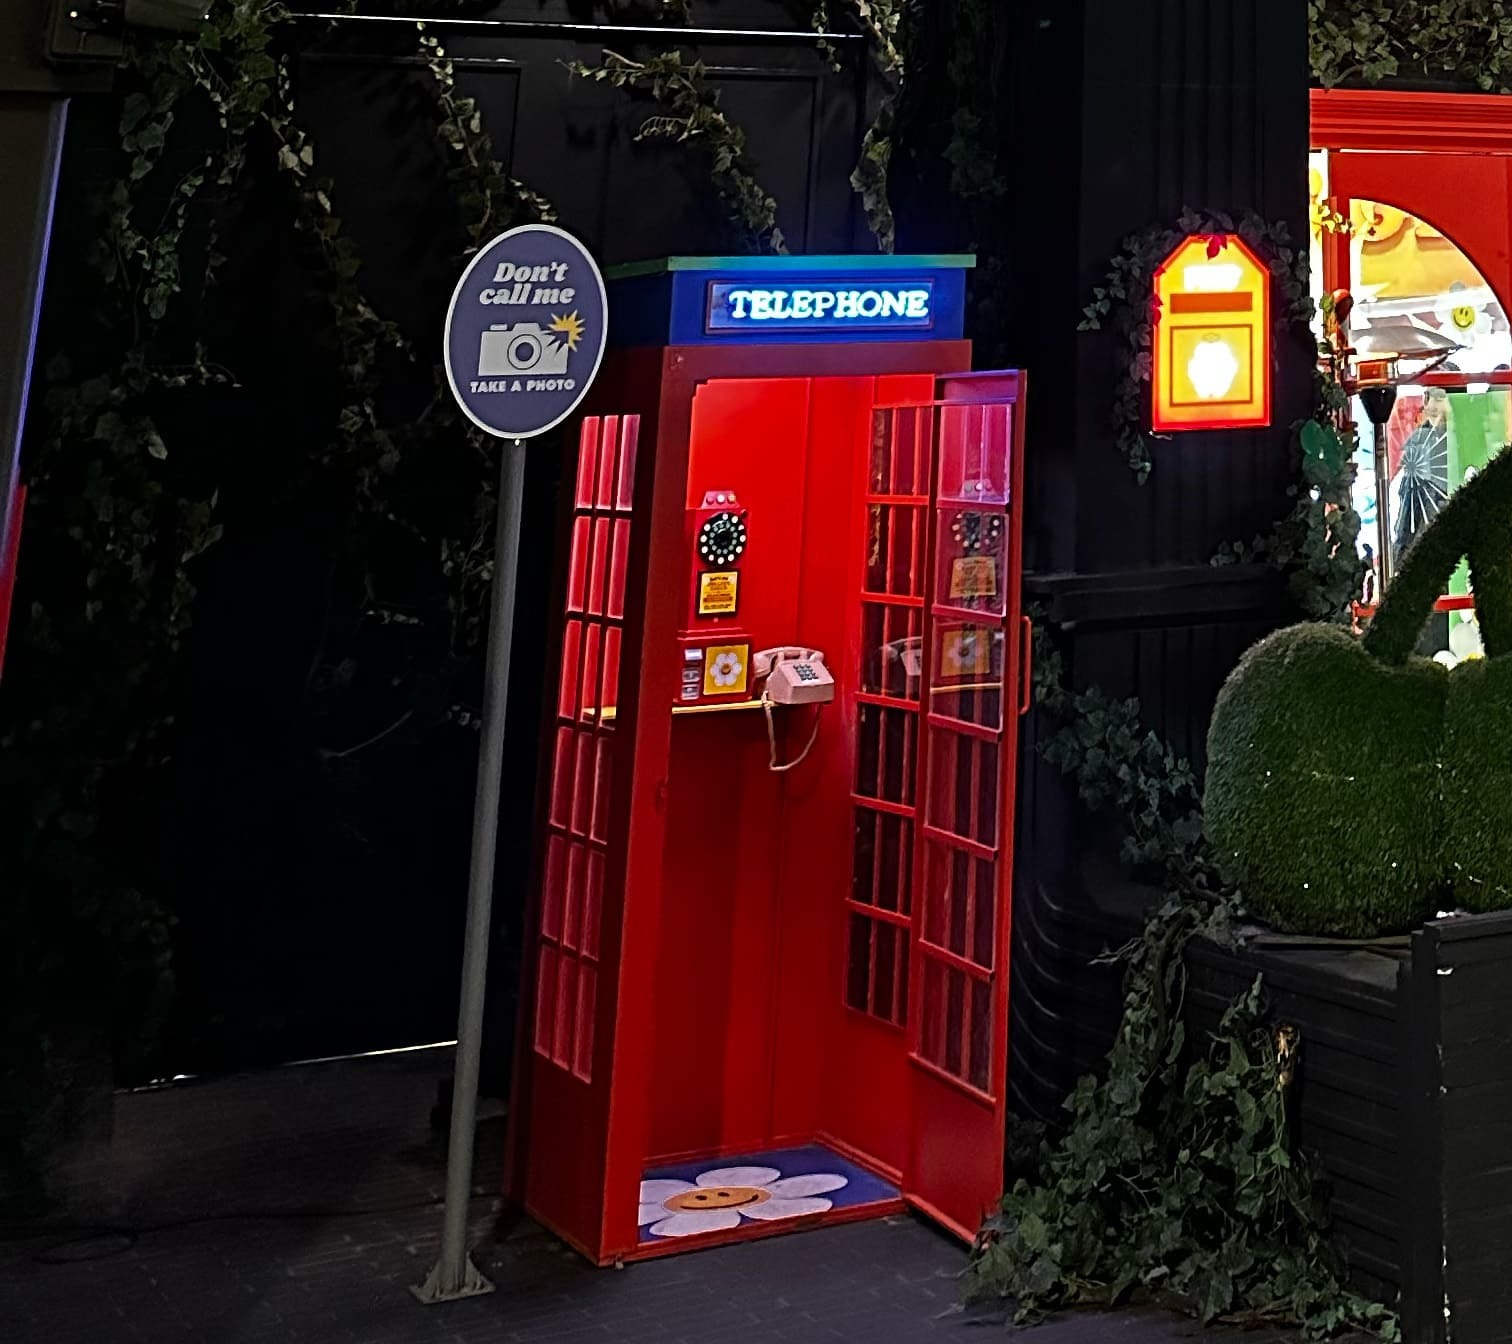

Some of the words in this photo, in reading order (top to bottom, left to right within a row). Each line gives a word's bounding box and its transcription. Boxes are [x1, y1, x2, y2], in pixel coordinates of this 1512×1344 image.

[480, 283, 532, 305] call
[531, 287, 576, 304] me
[728, 290, 929, 320] TELEPHONE
[470, 380, 507, 393] TAKE
[511, 380, 522, 392] A
[526, 379, 576, 392] PHOTO
